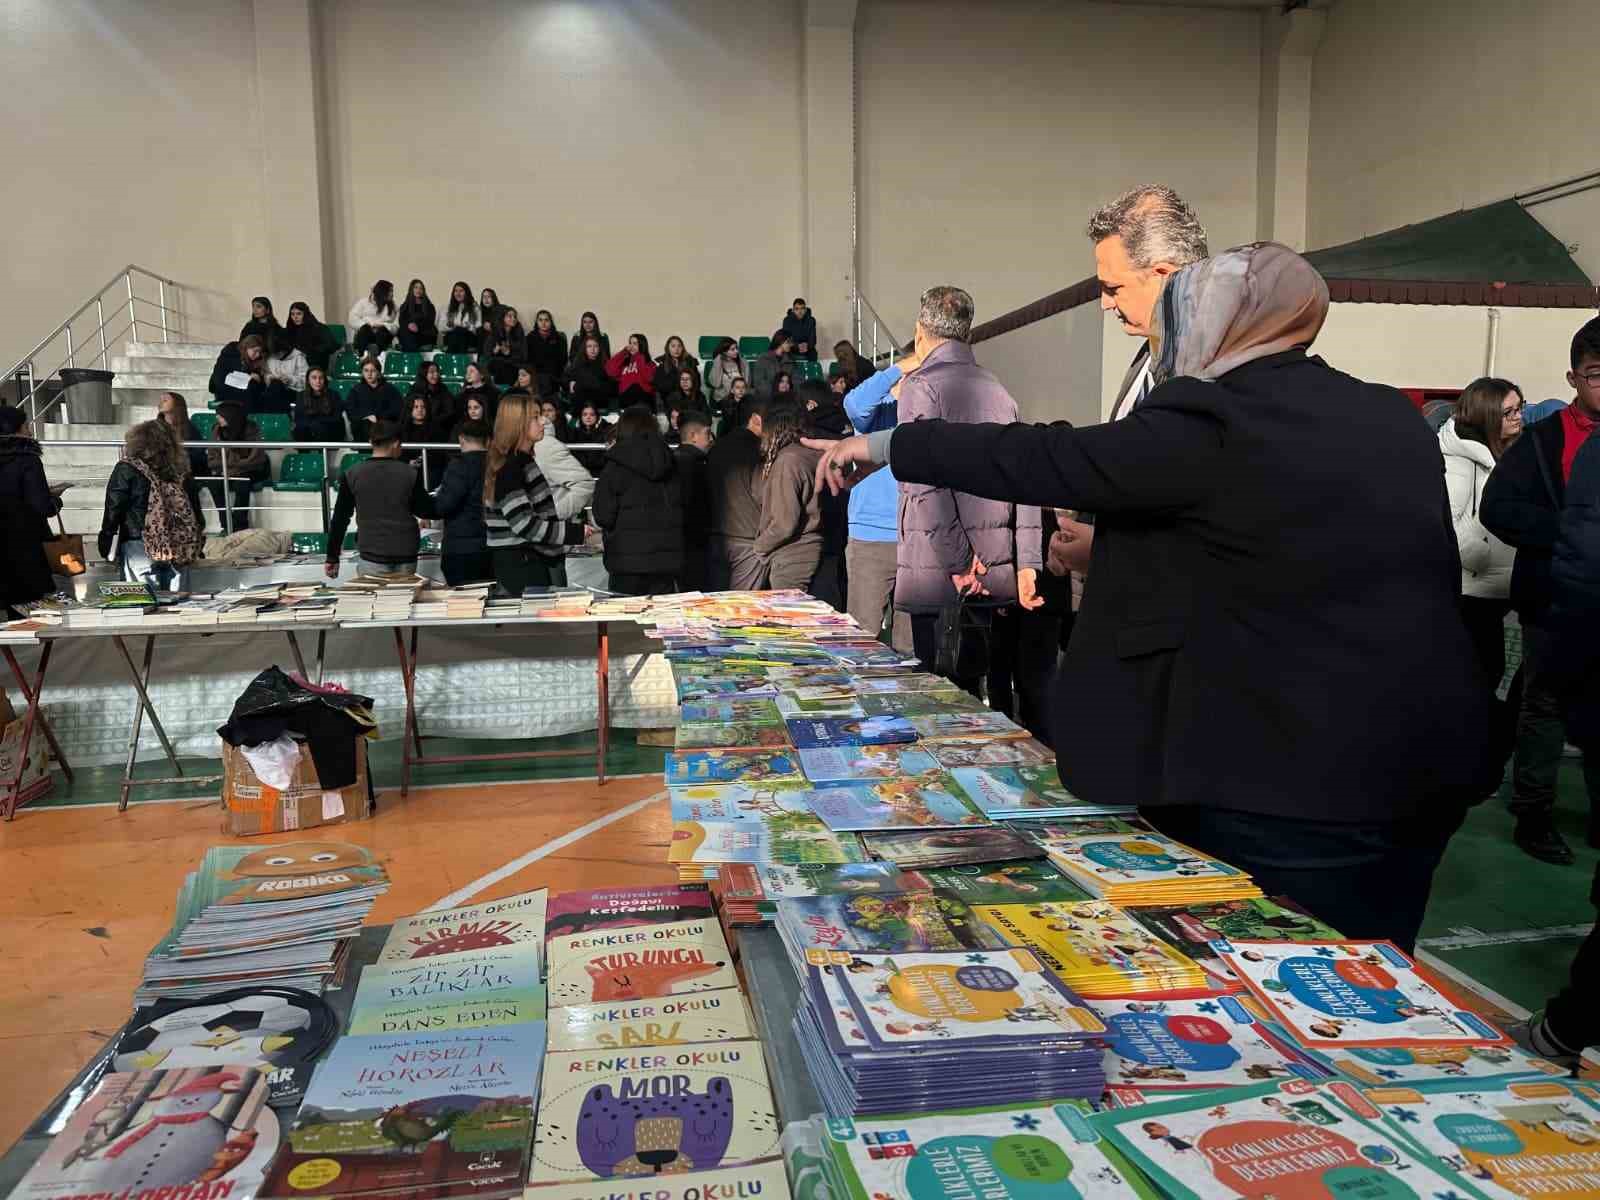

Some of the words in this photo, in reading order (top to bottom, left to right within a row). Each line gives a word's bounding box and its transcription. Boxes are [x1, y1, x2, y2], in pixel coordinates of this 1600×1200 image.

[408, 910, 480, 927] RENKLER
[485, 898, 532, 914] OKULU
[570, 932, 647, 949] RENKLER
[653, 926, 703, 939] OKULU
[589, 948, 705, 970] TURUNCU
[390, 975, 512, 997] BALIKLAR
[663, 998, 721, 1014] OKULU
[382, 1016, 446, 1032] DANS
[456, 1005, 518, 1023] EDEN
[596, 1021, 682, 1049] SARI
[358, 1062, 505, 1084] HOROZLAR
[569, 1055, 667, 1073] RENKLER
[676, 1051, 741, 1067] OKULU
[619, 1074, 697, 1100] MOR
